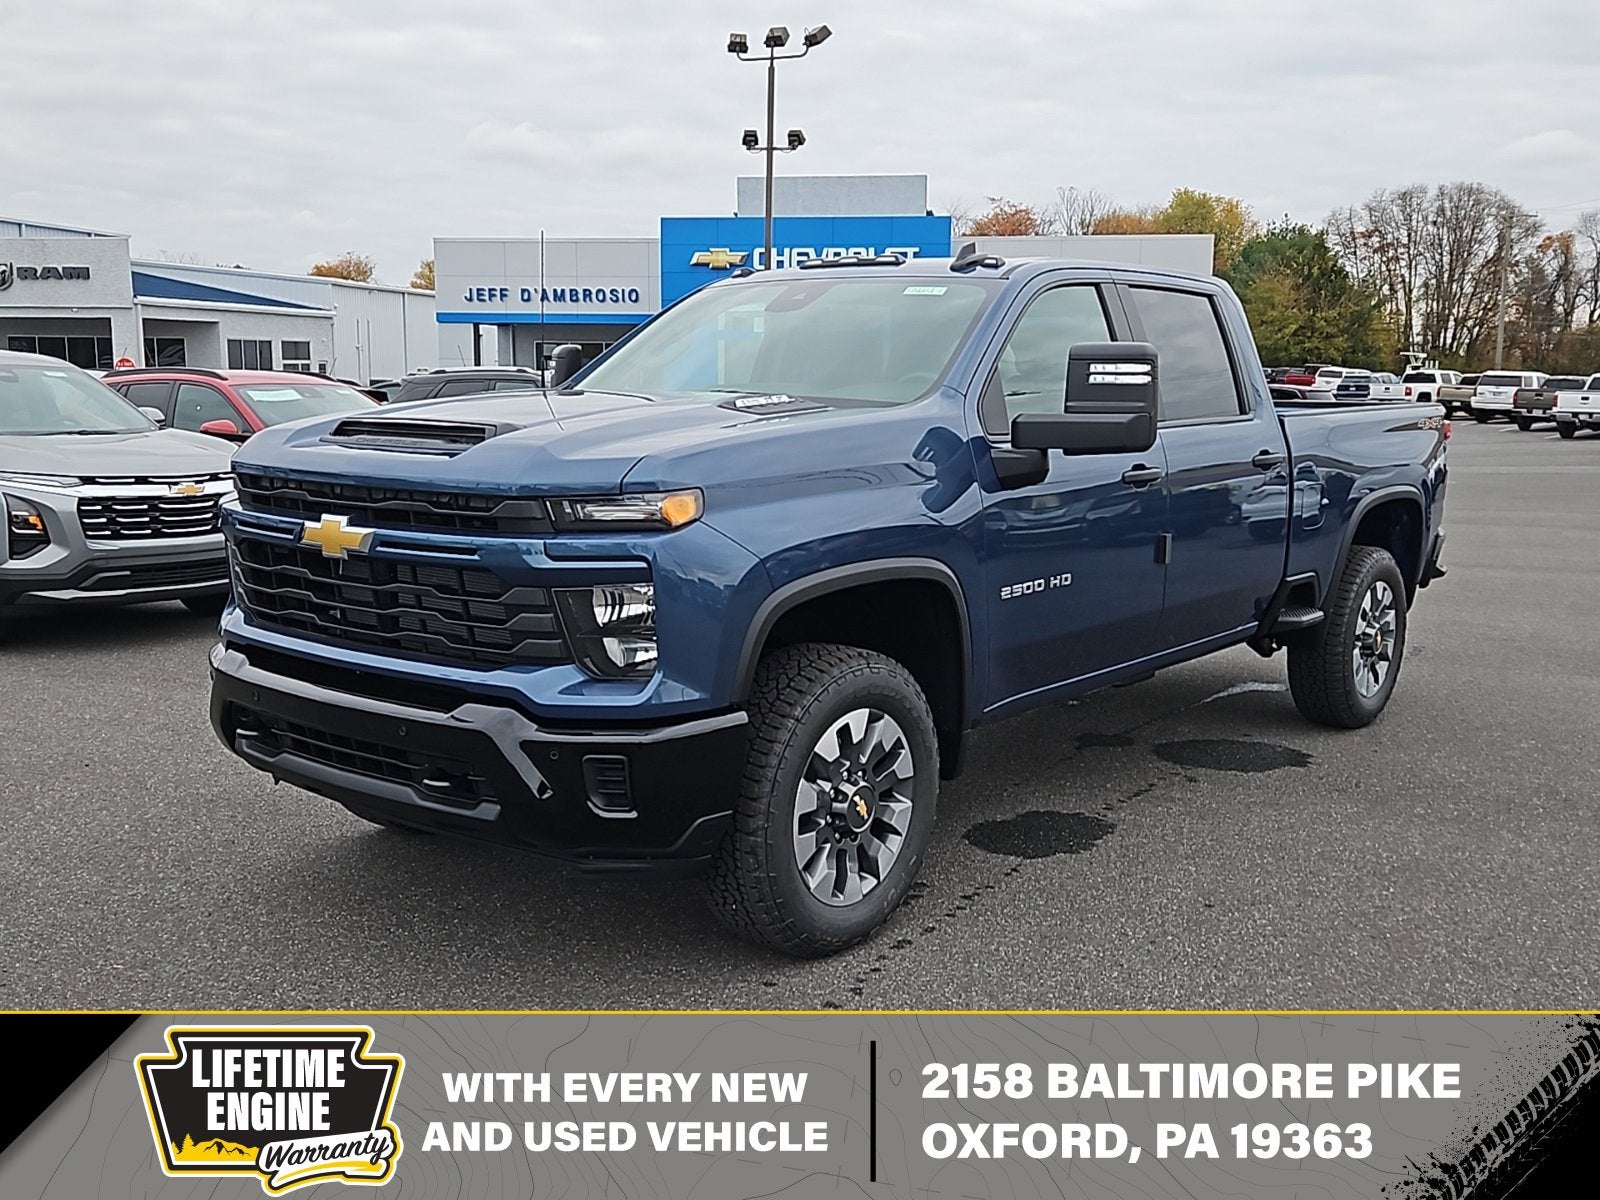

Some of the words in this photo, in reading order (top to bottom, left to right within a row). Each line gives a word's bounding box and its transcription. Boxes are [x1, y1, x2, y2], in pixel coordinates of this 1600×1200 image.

[752, 247, 920, 270] CHEVRT
[16, 266, 91, 280] RAM
[464, 287, 510, 302] JEFF
[520, 288, 641, 303] D'AMBROSIO
[1000, 578, 1045, 600] 2500
[1049, 573, 1072, 588] HD
